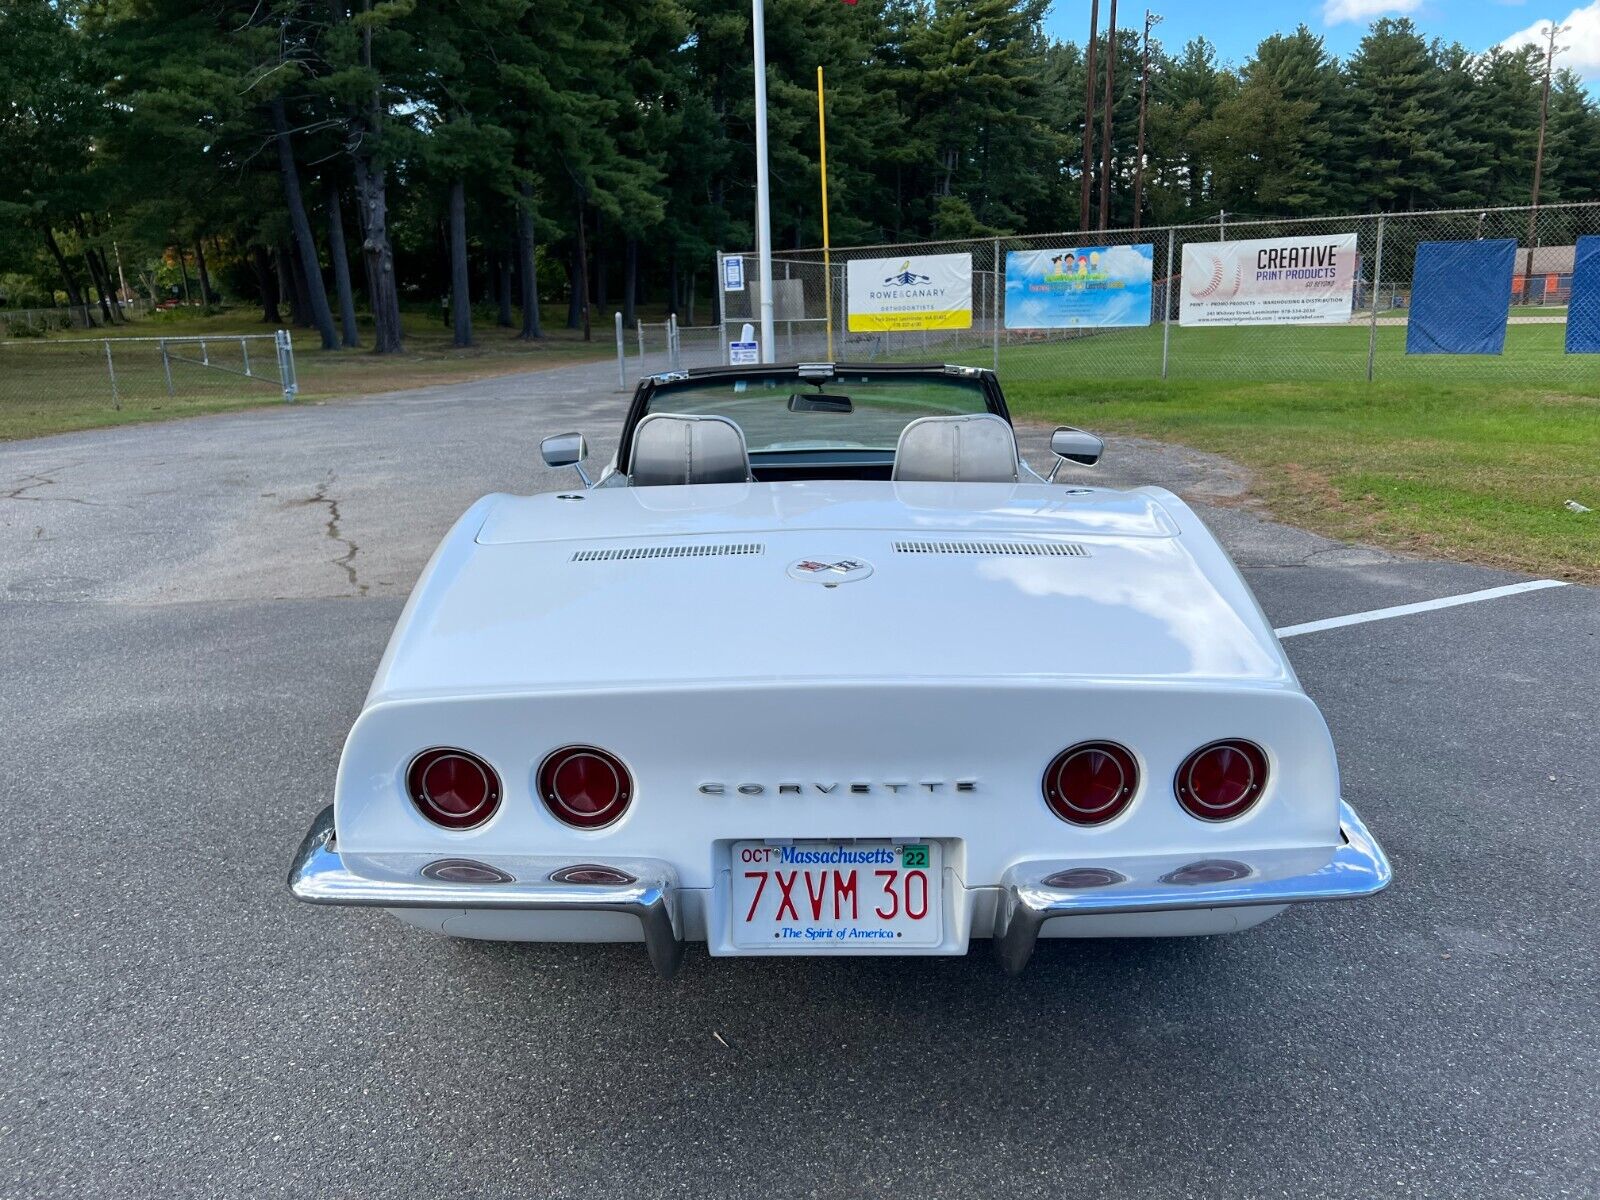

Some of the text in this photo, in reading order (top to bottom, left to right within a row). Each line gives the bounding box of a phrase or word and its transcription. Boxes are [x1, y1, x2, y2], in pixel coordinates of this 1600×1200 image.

[1257, 245, 1337, 269] CREATIVE
[1256, 268, 1336, 281] PRINT PRODUCTS
[1314, 280, 1335, 288] BEYOND
[698, 782, 977, 795] CORVETTE
[741, 846, 925, 866] OCT Massachusetts 22
[744, 869, 929, 922] 7XVM 30
[782, 927, 894, 941] The Spirit of America
